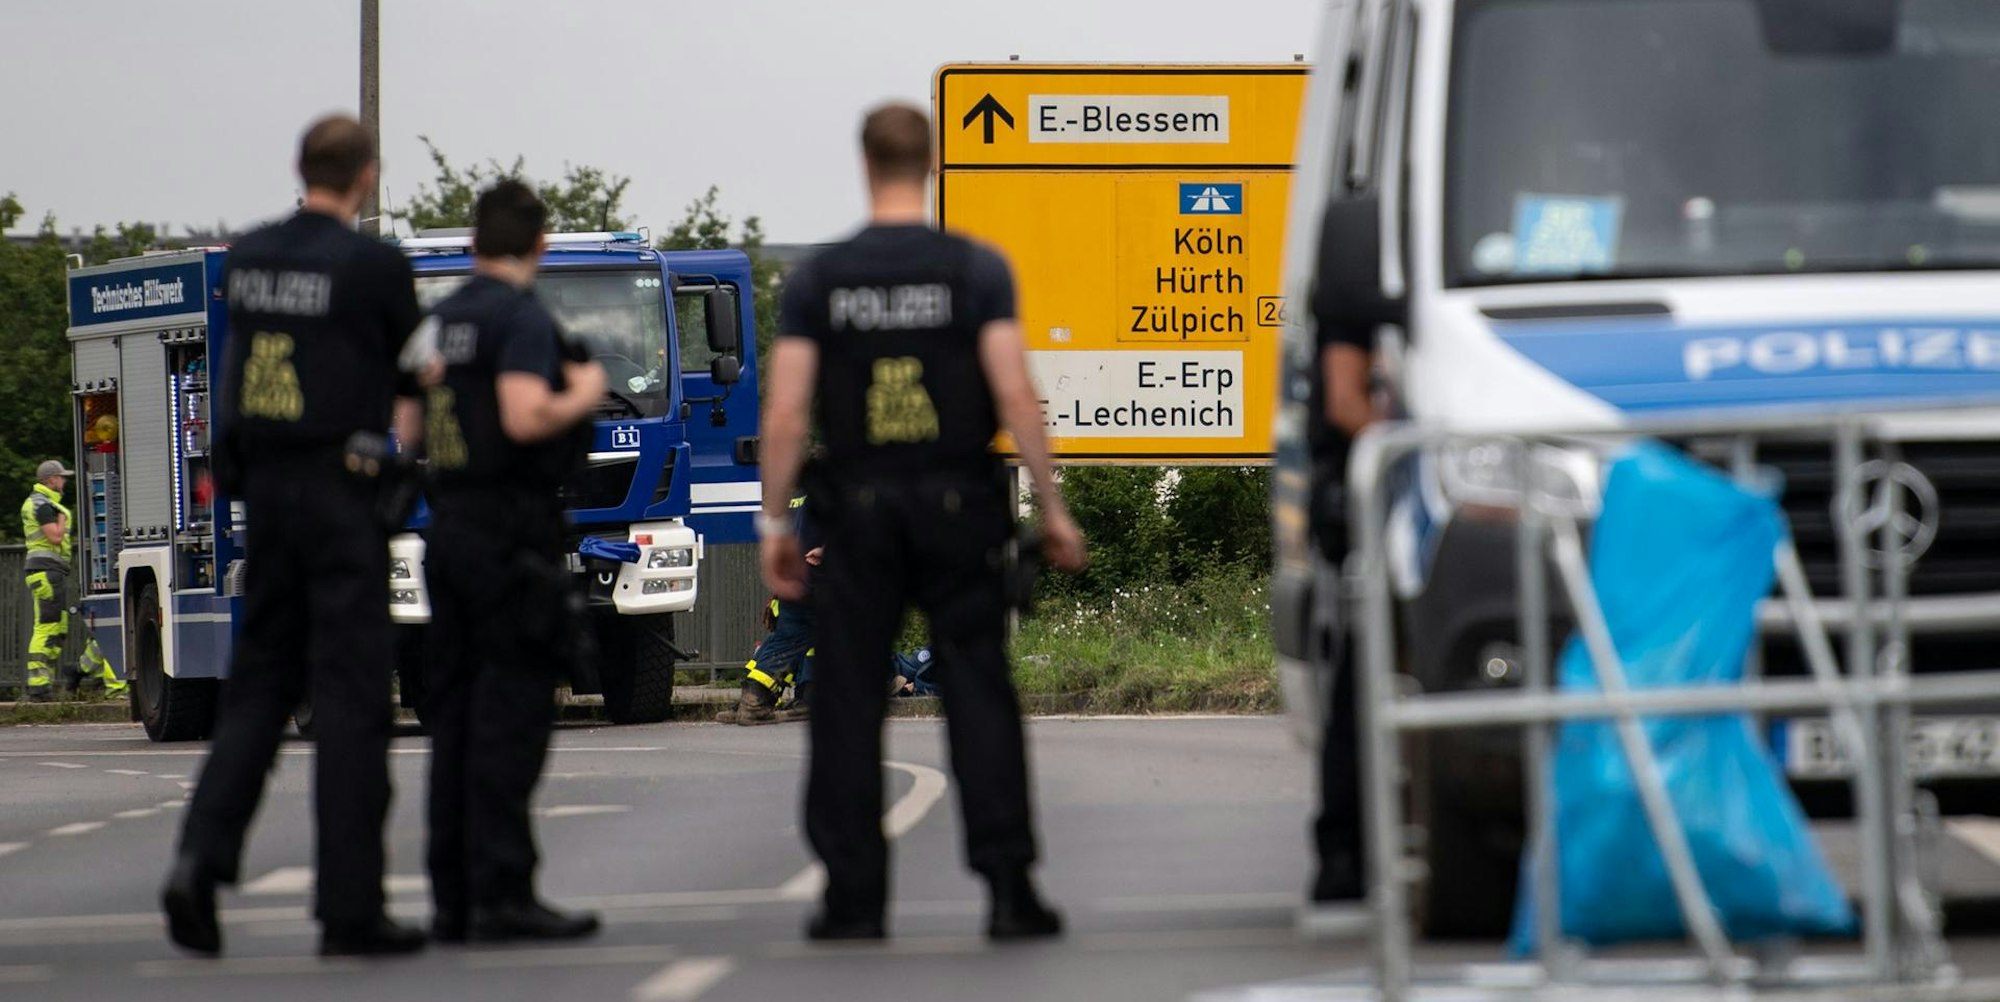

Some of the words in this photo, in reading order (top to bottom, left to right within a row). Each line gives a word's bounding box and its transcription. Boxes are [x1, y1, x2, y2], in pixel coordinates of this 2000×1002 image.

[1039, 105, 1220, 133] E.-Blessem
[1174, 228, 1244, 255] Köln
[91, 282, 144, 314] Technisches
[143, 277, 184, 307] Hilfswerk
[229, 268, 332, 317] POLIZEI
[1156, 267, 1244, 294] Hürth
[829, 284, 952, 330] POLIZEI
[1130, 306, 1244, 340] Zülpich
[1264, 301, 1288, 322] 26
[1683, 327, 2000, 382] POLIZE
[1138, 361, 1234, 395] E.-Erp
